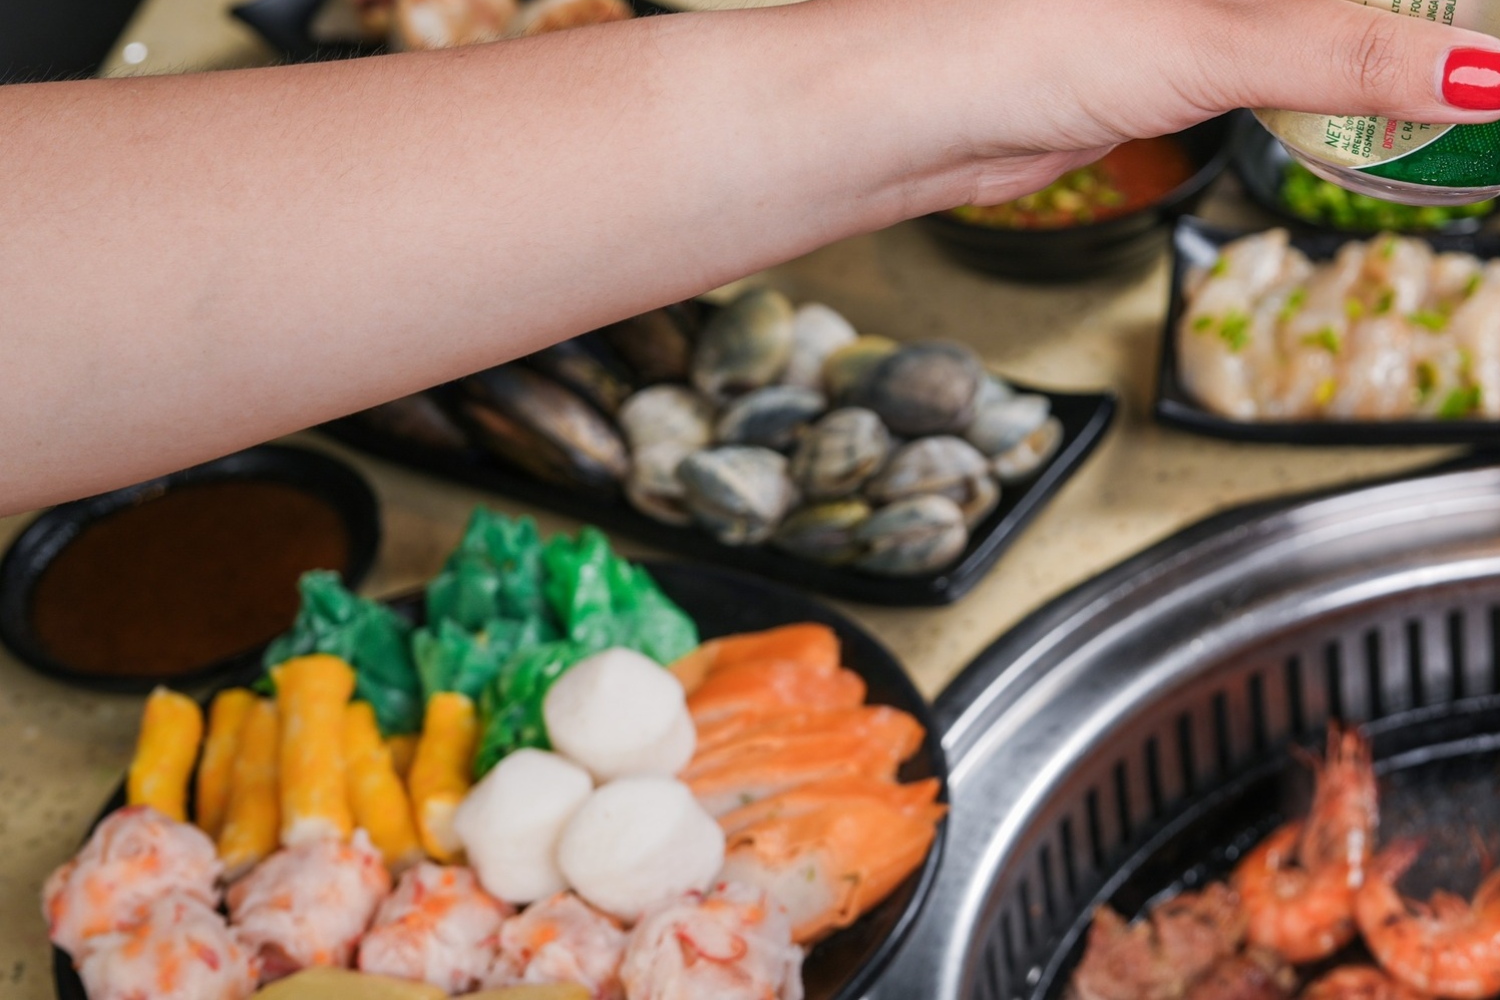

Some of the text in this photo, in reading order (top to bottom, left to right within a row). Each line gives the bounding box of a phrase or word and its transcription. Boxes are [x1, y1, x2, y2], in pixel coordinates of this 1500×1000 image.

[1324, 119, 1342, 148] NET
[1351, 119, 1366, 155] BREWED
[1362, 124, 1377, 158] COSMOS
